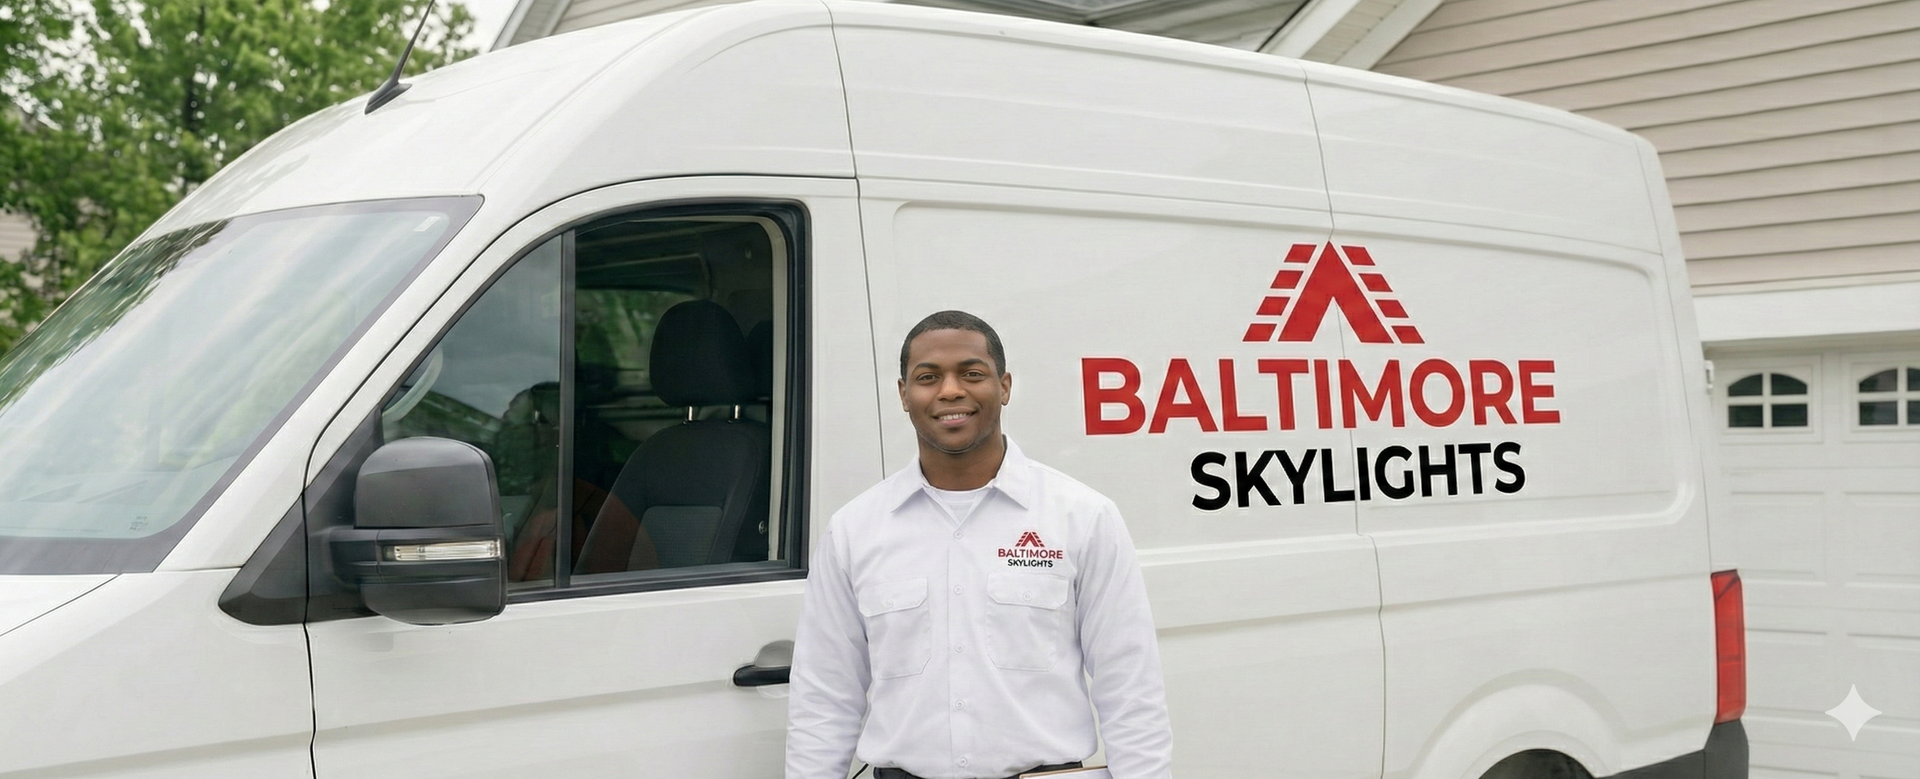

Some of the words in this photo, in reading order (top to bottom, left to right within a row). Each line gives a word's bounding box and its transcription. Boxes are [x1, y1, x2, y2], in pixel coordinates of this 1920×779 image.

[1081, 357, 1561, 436] BALTIMORE
[1191, 442, 1526, 511] SKYLIGHTS
[998, 548, 1063, 559] BALTIMORE
[1007, 559, 1054, 568] SKYLIGHTS
